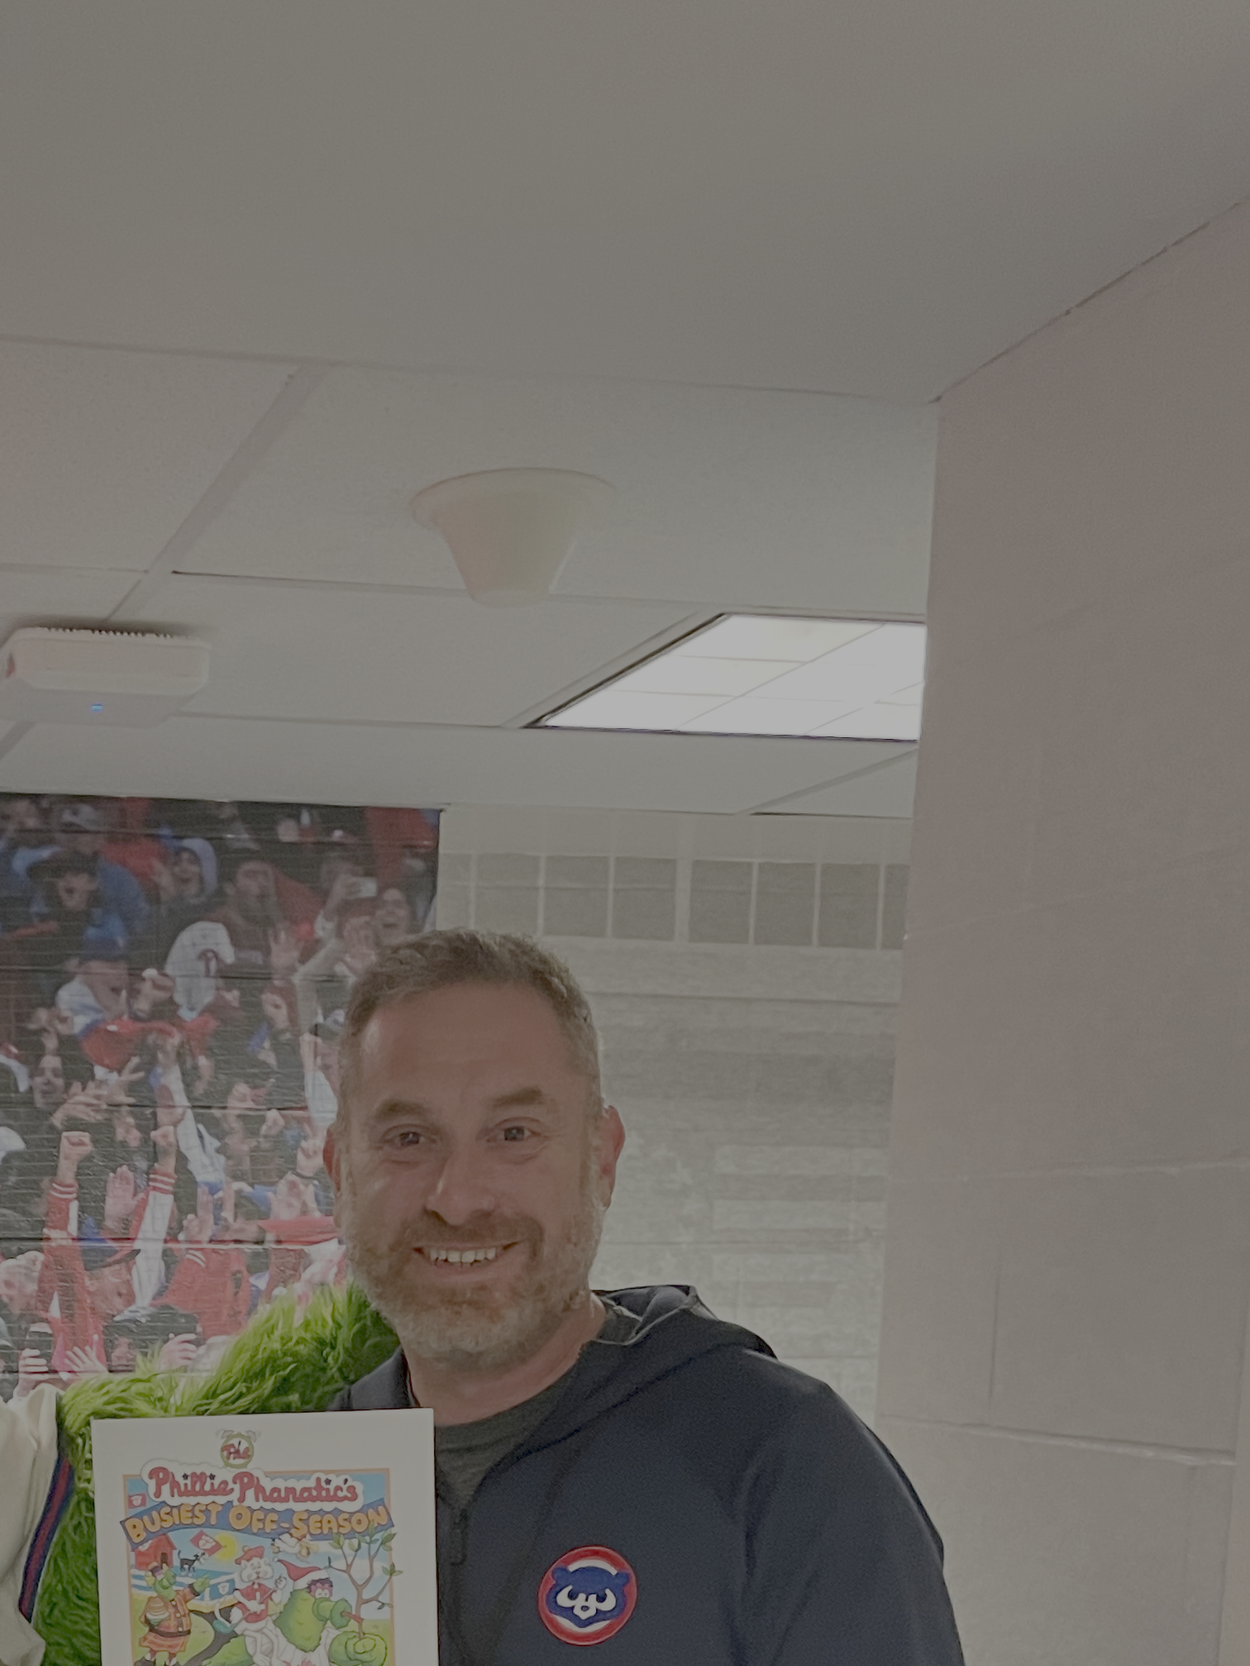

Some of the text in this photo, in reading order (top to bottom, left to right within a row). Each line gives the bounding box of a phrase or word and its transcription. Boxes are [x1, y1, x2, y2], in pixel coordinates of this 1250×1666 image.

[220, 1443, 251, 1461] The
[148, 1466, 359, 1504] Phillie Phanatic's
[124, 1502, 223, 1544] BUSIEST
